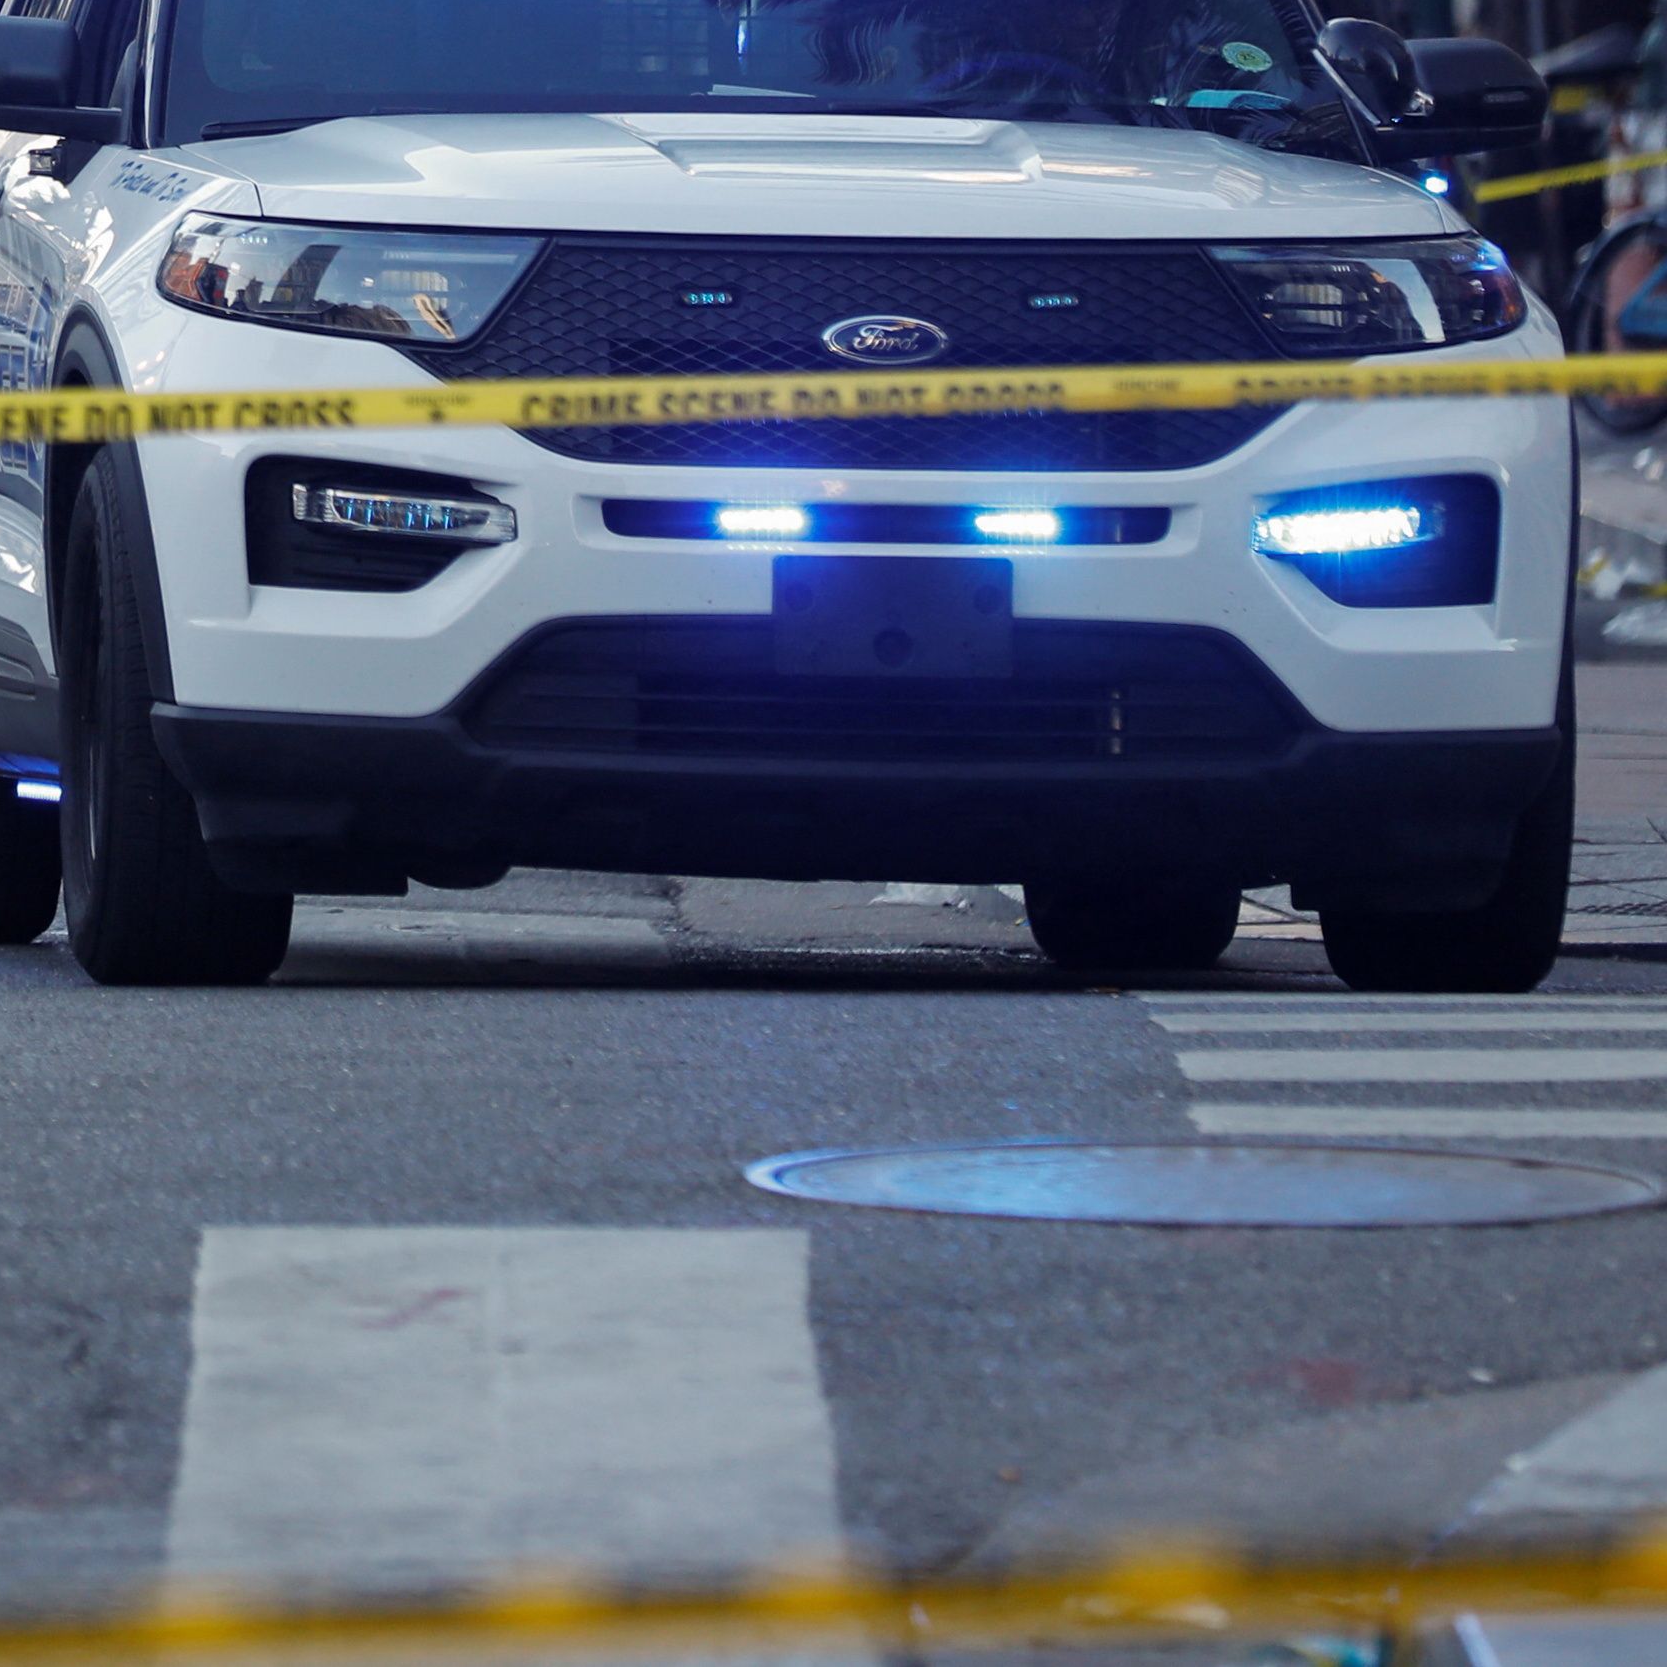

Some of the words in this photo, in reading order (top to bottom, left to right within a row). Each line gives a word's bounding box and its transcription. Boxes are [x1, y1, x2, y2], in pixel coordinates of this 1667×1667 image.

[852, 323, 920, 351] Ford
[87, 403, 134, 441] DO
[149, 401, 220, 434] NOT
[233, 398, 358, 431] CROSS
